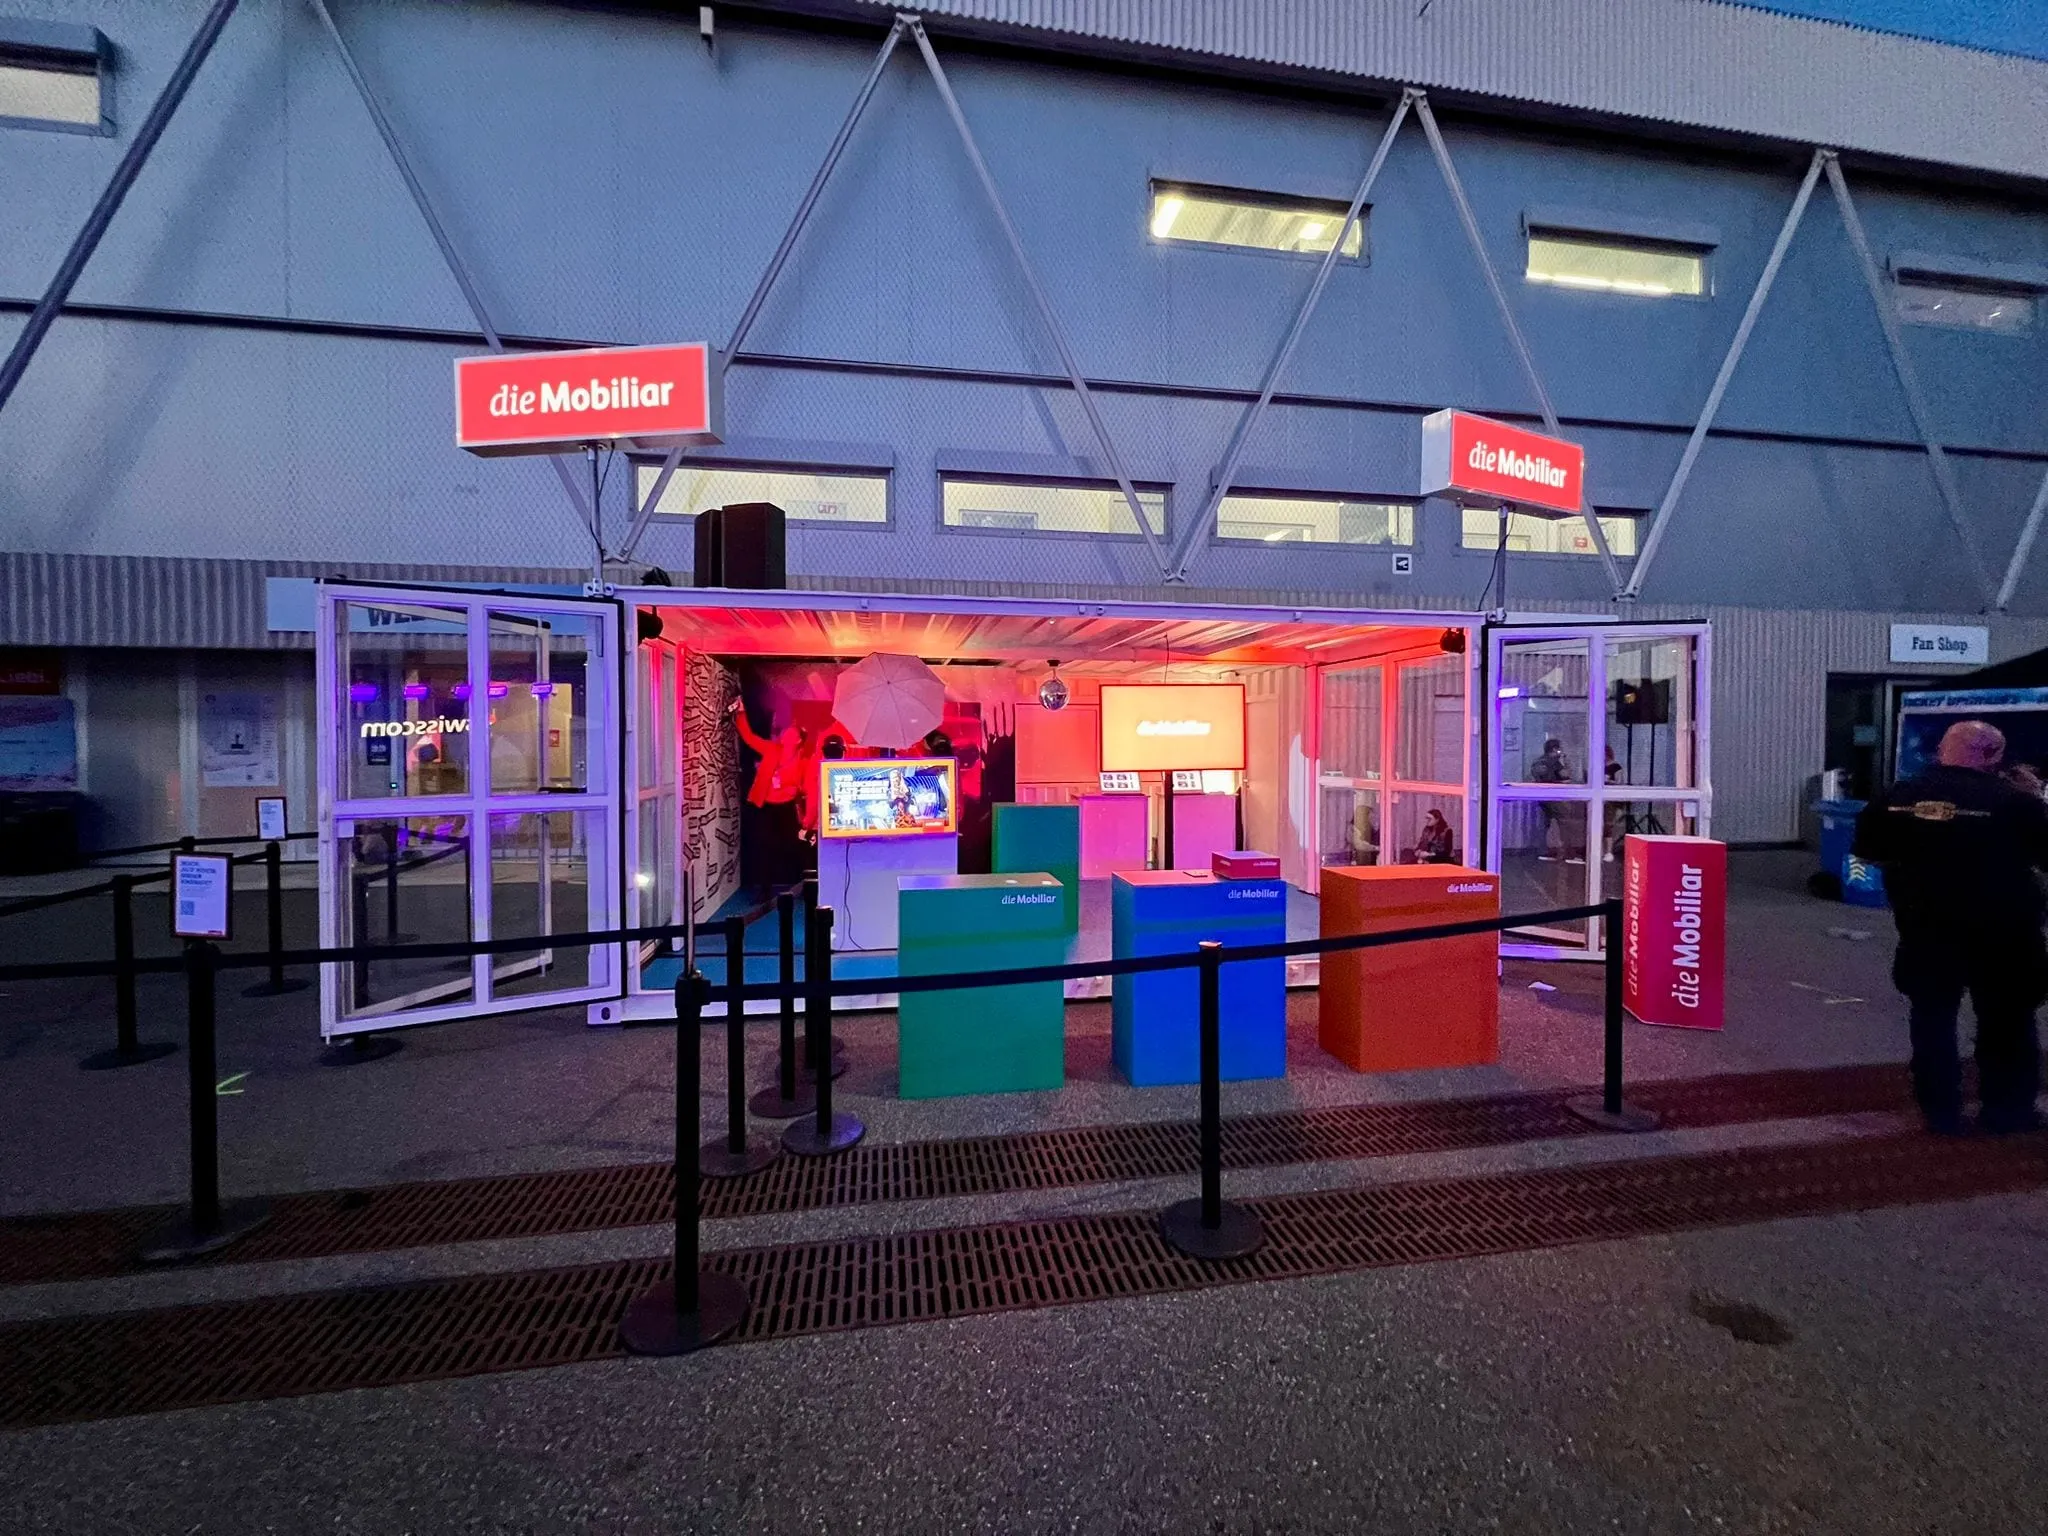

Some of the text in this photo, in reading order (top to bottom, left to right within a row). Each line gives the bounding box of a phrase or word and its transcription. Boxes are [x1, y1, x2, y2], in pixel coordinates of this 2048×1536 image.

[490, 377, 674, 416] die Mobiliar
[1468, 440, 1567, 488] die Mobiliar
[1912, 636, 1968, 654] Fan Shop
[1001, 893, 1057, 905] die Mobiliar
[1228, 888, 1280, 899] die Mobiliar
[1627, 856, 1640, 996] die Mobiliar
[1672, 863, 1703, 1009] die Mobiliar
